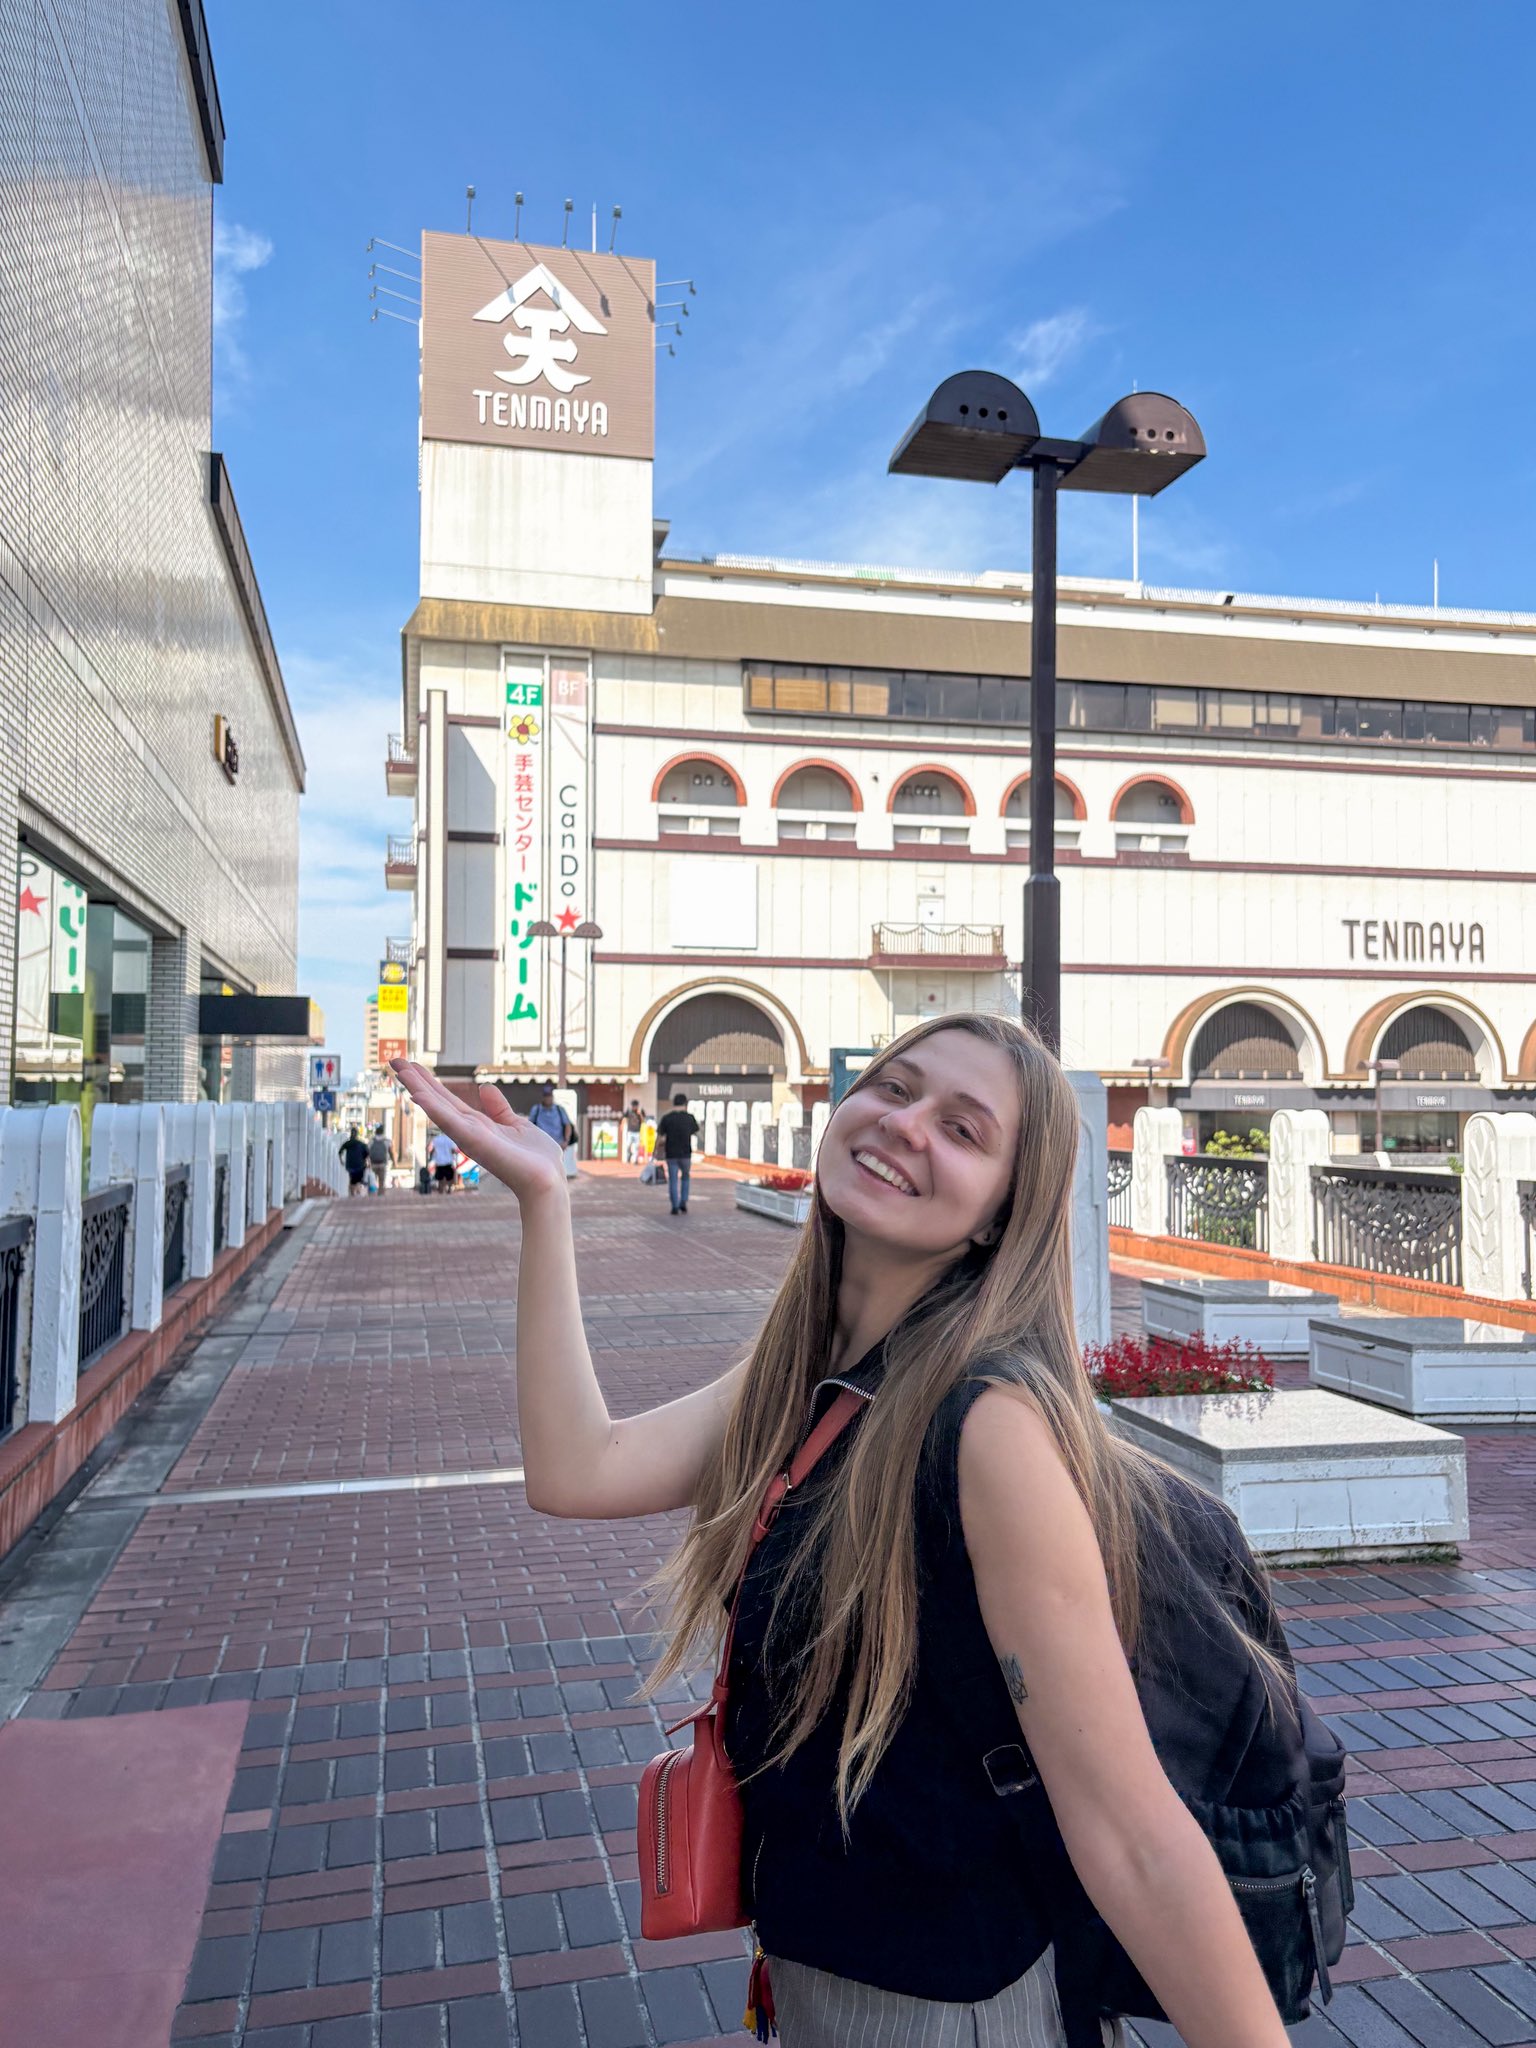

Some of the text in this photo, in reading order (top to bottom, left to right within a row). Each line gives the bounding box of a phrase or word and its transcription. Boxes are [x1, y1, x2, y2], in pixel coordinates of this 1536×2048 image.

[471, 388, 609, 436] TENMAYA
[509, 684, 540, 706] 4F
[514, 753, 534, 873] 手芸センター
[558, 784, 580, 897] CanDo
[1340, 919, 1486, 964] TENMAYA
